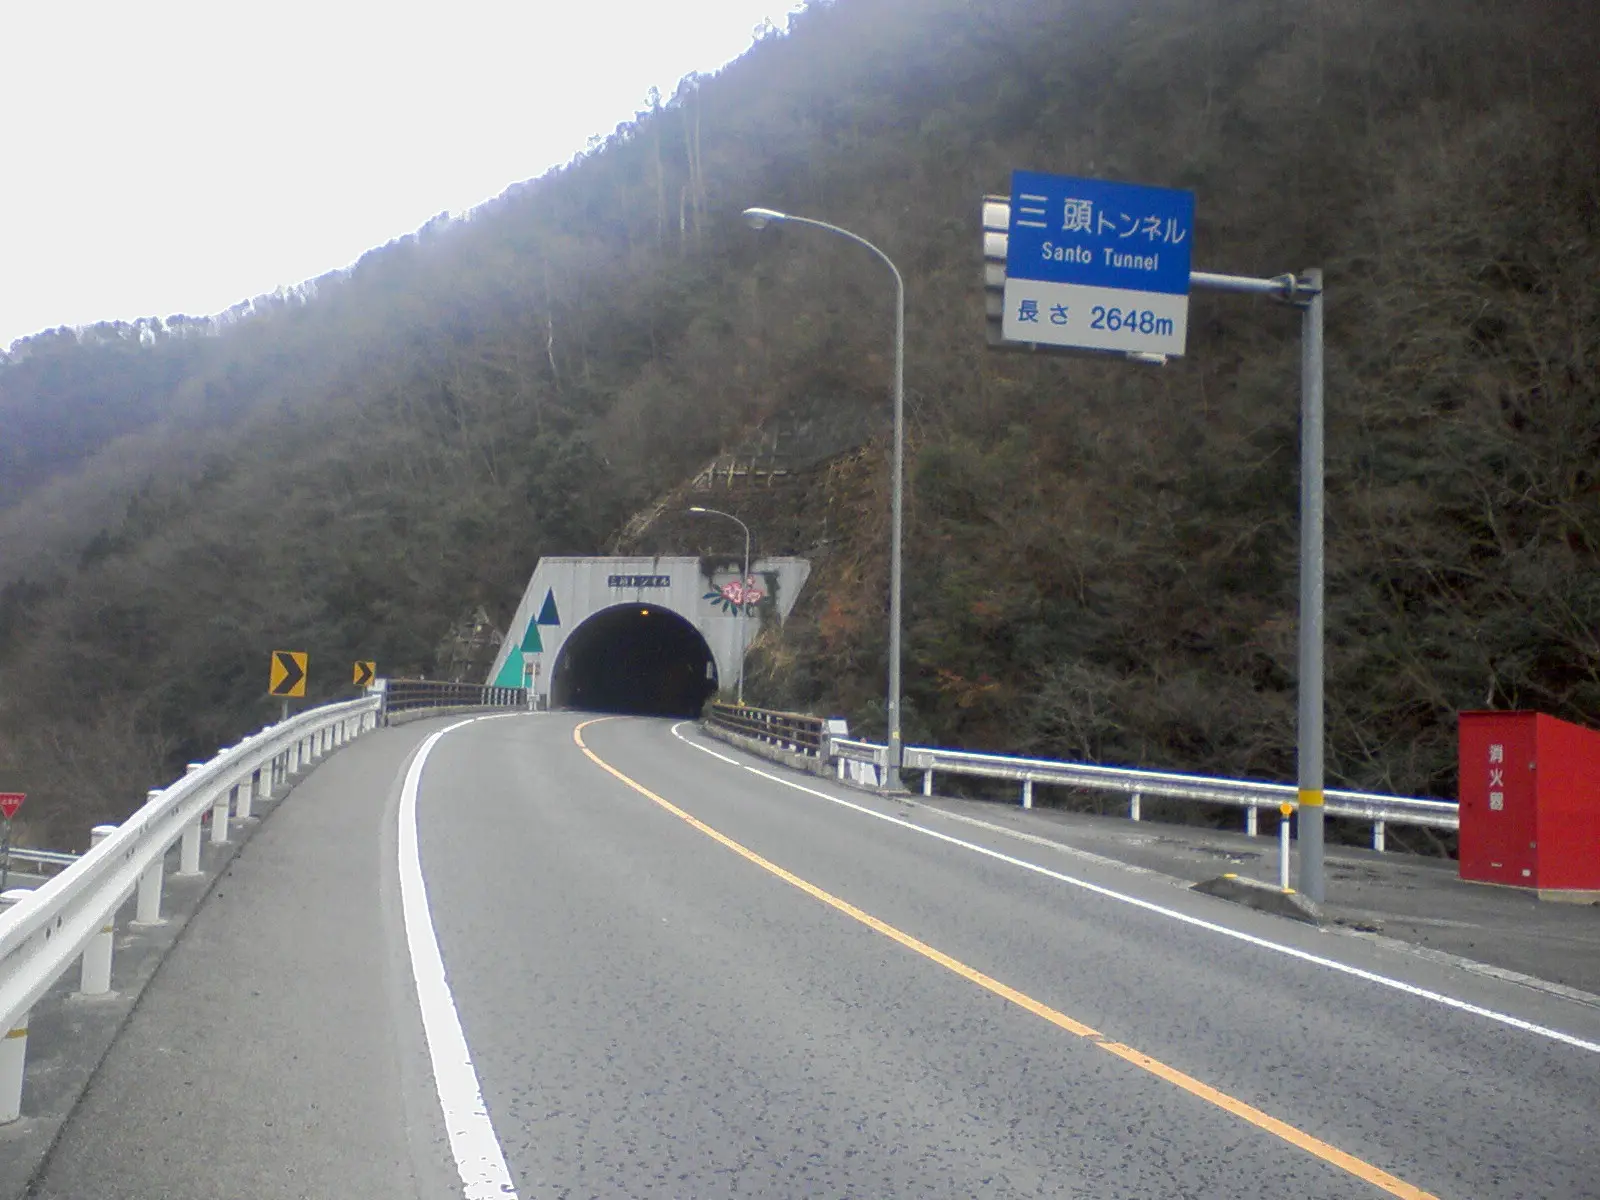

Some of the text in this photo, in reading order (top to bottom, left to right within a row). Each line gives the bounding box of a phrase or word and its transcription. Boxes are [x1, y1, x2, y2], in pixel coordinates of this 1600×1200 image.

[1016, 194, 1187, 244] 三頭トンネル
[1041, 242, 1159, 271] Santo Tunnel
[1018, 300, 1173, 336] 長さ 2648m
